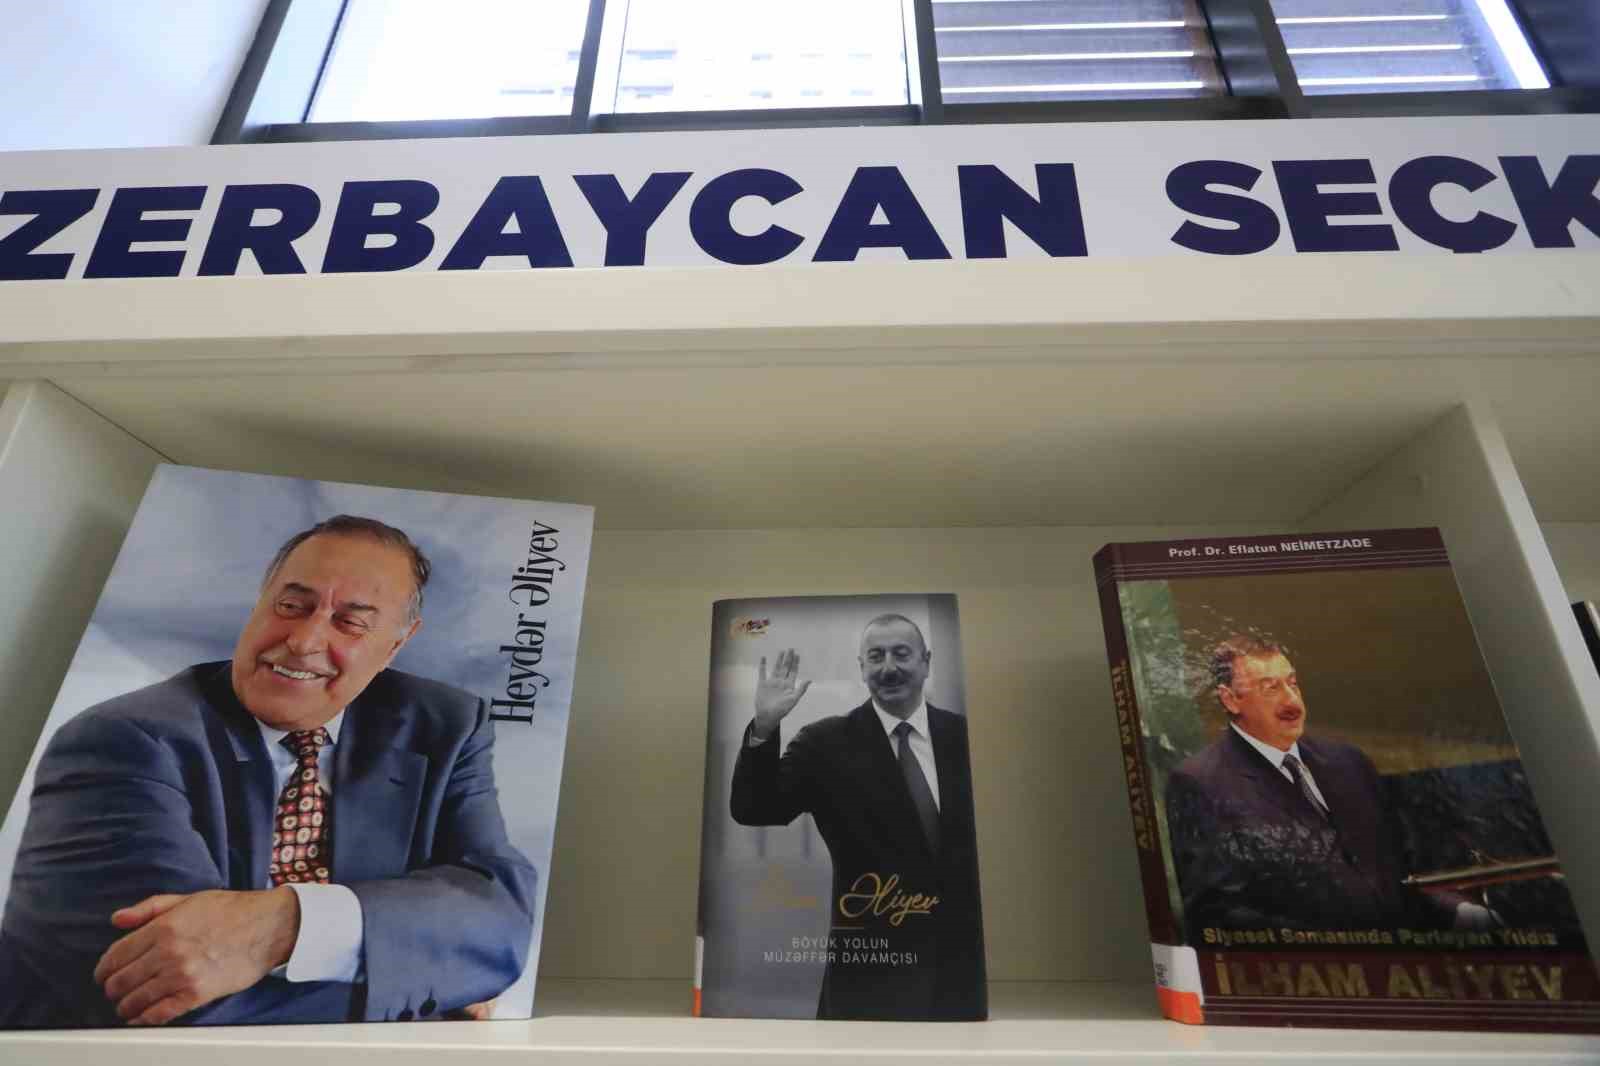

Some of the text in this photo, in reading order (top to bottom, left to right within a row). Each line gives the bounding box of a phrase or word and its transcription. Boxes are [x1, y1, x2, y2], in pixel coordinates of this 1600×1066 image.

[0, 163, 1089, 280] ZERBAYCAN
[1168, 538, 1373, 558] Prof. Dr. Eflatun NEİMETZADE
[488, 520, 566, 727] Heydər Əliyev
[791, 936, 889, 950] BÖYÜK YOLUN
[842, 951, 919, 966] DAVAMÇISI
[1215, 953, 1371, 997] İLHAM
